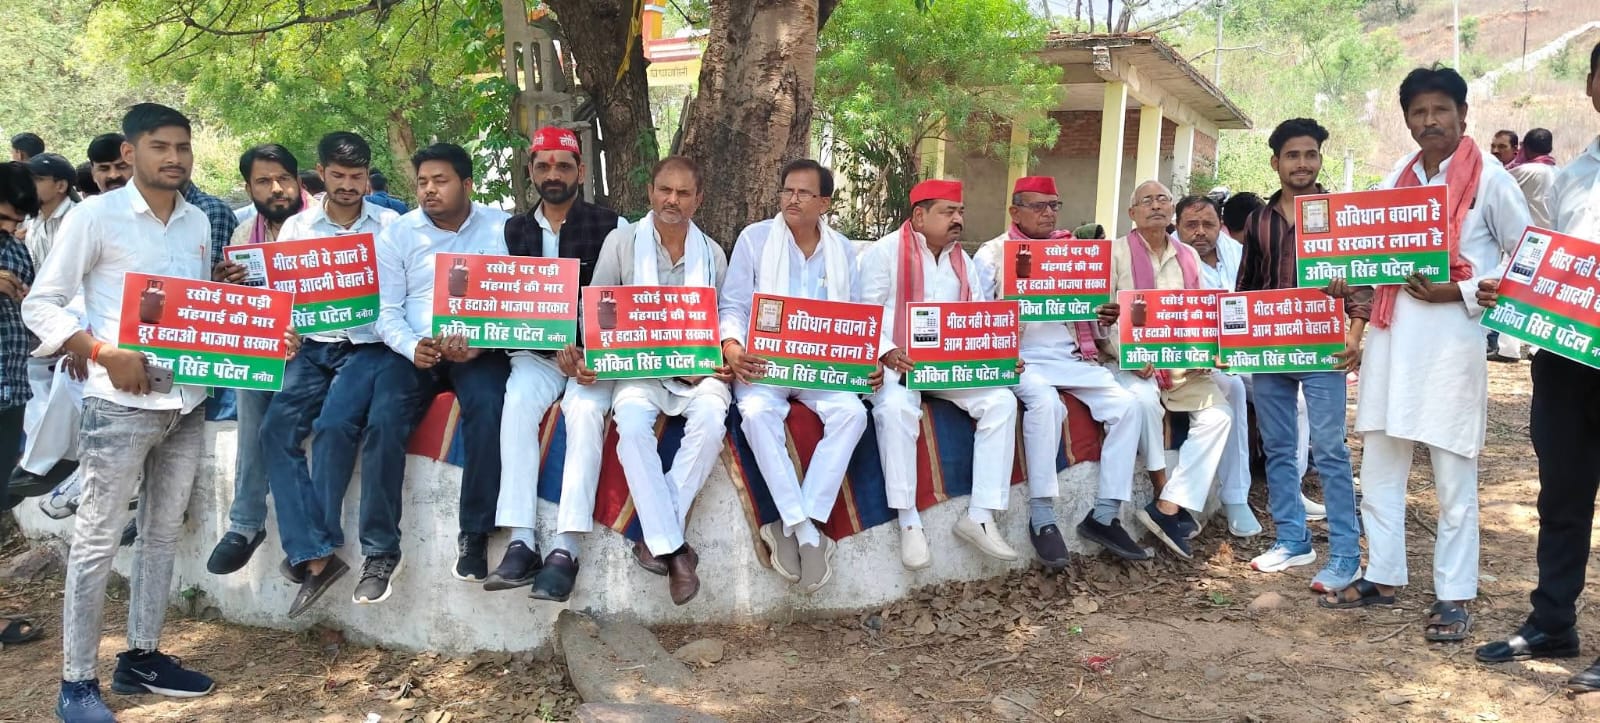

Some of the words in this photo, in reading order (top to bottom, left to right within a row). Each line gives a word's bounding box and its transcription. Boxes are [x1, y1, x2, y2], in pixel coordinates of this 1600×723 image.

[1336, 205, 1385, 226] संविधान
[1388, 205, 1428, 223] बचाना
[1428, 198, 1441, 221] है
[1303, 239, 1334, 252] सपा
[1338, 235, 1385, 250] सरकार
[1389, 233, 1428, 248] लाना
[1428, 227, 1444, 246] है
[272, 253, 298, 270] मीटर
[321, 248, 331, 266] ये
[334, 249, 358, 264] जाल
[357, 244, 368, 262] है
[1045, 244, 1068, 256] रसोई
[1071, 247, 1082, 255] पर
[1085, 245, 1099, 257] पड़ी
[1549, 247, 1575, 272] मीटर
[486, 261, 517, 275] रसोई
[520, 265, 535, 274] पर
[539, 264, 559, 277] पड़ी
[1074, 260, 1086, 271] की
[1089, 262, 1103, 270] मार
[1306, 262, 1347, 280] अंकित
[1351, 259, 1379, 277] सिंह
[1382, 258, 1415, 276] पटेल
[300, 272, 334, 293] आदमी
[336, 270, 365, 288] बेहाल
[364, 267, 374, 284] है
[524, 281, 540, 292] की
[544, 284, 564, 293] मार
[1016, 280, 1027, 294] दूर
[1029, 276, 1055, 290] हटाओ
[1058, 279, 1083, 289] भाजपा
[1085, 279, 1106, 288] सरकार
[186, 287, 222, 304] रसोई
[225, 293, 242, 305] पर
[248, 295, 272, 310] पड़ी
[633, 290, 661, 304] रसोई
[664, 294, 678, 303] पर
[682, 292, 700, 305] पड़ी
[1160, 294, 1184, 305] रसोई
[1187, 296, 1198, 304] पर
[1200, 294, 1216, 306] पड़ी
[1533, 276, 1558, 297] आम
[1556, 283, 1595, 309] आदमी
[319, 305, 352, 322] पटेल
[449, 298, 462, 315] दूर
[465, 296, 497, 313] हटाओ
[501, 301, 534, 313] भाजपा
[537, 302, 569, 313] सरकार
[670, 308, 685, 320] की
[688, 311, 706, 320] मार
[1046, 299, 1066, 315] सिंह
[1068, 298, 1091, 314] पटेल
[1191, 310, 1202, 319] की
[1254, 301, 1274, 316] मीटर
[1294, 298, 1303, 313] ये
[1305, 300, 1326, 313] जाल
[1326, 295, 1336, 312] है
[229, 312, 248, 325] की
[251, 316, 275, 328] मार
[787, 310, 832, 333] संविधान
[834, 319, 867, 336] बचाना
[868, 316, 877, 336] है
[947, 312, 966, 329] मीटर
[984, 311, 991, 327] ये
[993, 315, 1008, 327] जाल
[1008, 310, 1015, 326] है
[1252, 324, 1272, 337] आम
[1274, 319, 1304, 336] आदमी
[1305, 318, 1330, 334] बेहाल
[1331, 317, 1340, 333] है
[1489, 302, 1527, 330] अंकित
[1525, 313, 1556, 339] सिंह
[1555, 324, 1592, 353] पटेल
[138, 325, 155, 344] दूर
[158, 326, 197, 344] हटाओ
[201, 331, 239, 346] भाजपा
[243, 336, 280, 351] सरकार
[484, 322, 511, 340] सिंह
[514, 323, 544, 342] पटेल
[600, 331, 614, 347] दूर
[616, 326, 647, 342] हटाओ
[651, 329, 683, 340] भाजपा
[685, 329, 713, 340] सरकार
[944, 338, 962, 351] आम
[965, 333, 990, 350] आदमी
[992, 332, 1010, 349] बेहाल
[1010, 331, 1016, 348] है
[1132, 328, 1142, 342] दूर
[1145, 325, 1171, 338] हटाओ
[1174, 328, 1200, 337] भाजपा
[754, 337, 782, 352] सपा
[785, 340, 828, 356] सरकार
[830, 344, 863, 359] लाना
[864, 343, 875, 360] है
[1126, 347, 1159, 363] अंकित
[1162, 347, 1182, 362] सिंह
[1185, 347, 1209, 362] पटेल
[1226, 351, 1259, 367] अंकित
[1263, 349, 1286, 366] सिंह
[1288, 349, 1317, 365] पटेल
[179, 355, 210, 376] सिंह
[213, 359, 250, 380] पटेल
[593, 353, 633, 372] अंकित
[637, 351, 662, 370] सिंह
[665, 351, 695, 369] पटेल
[793, 364, 818, 382] सिंह
[820, 366, 848, 384] पटेल
[914, 365, 950, 383] अंकित
[952, 365, 973, 382] सिंह
[976, 364, 1000, 380] पटेल
